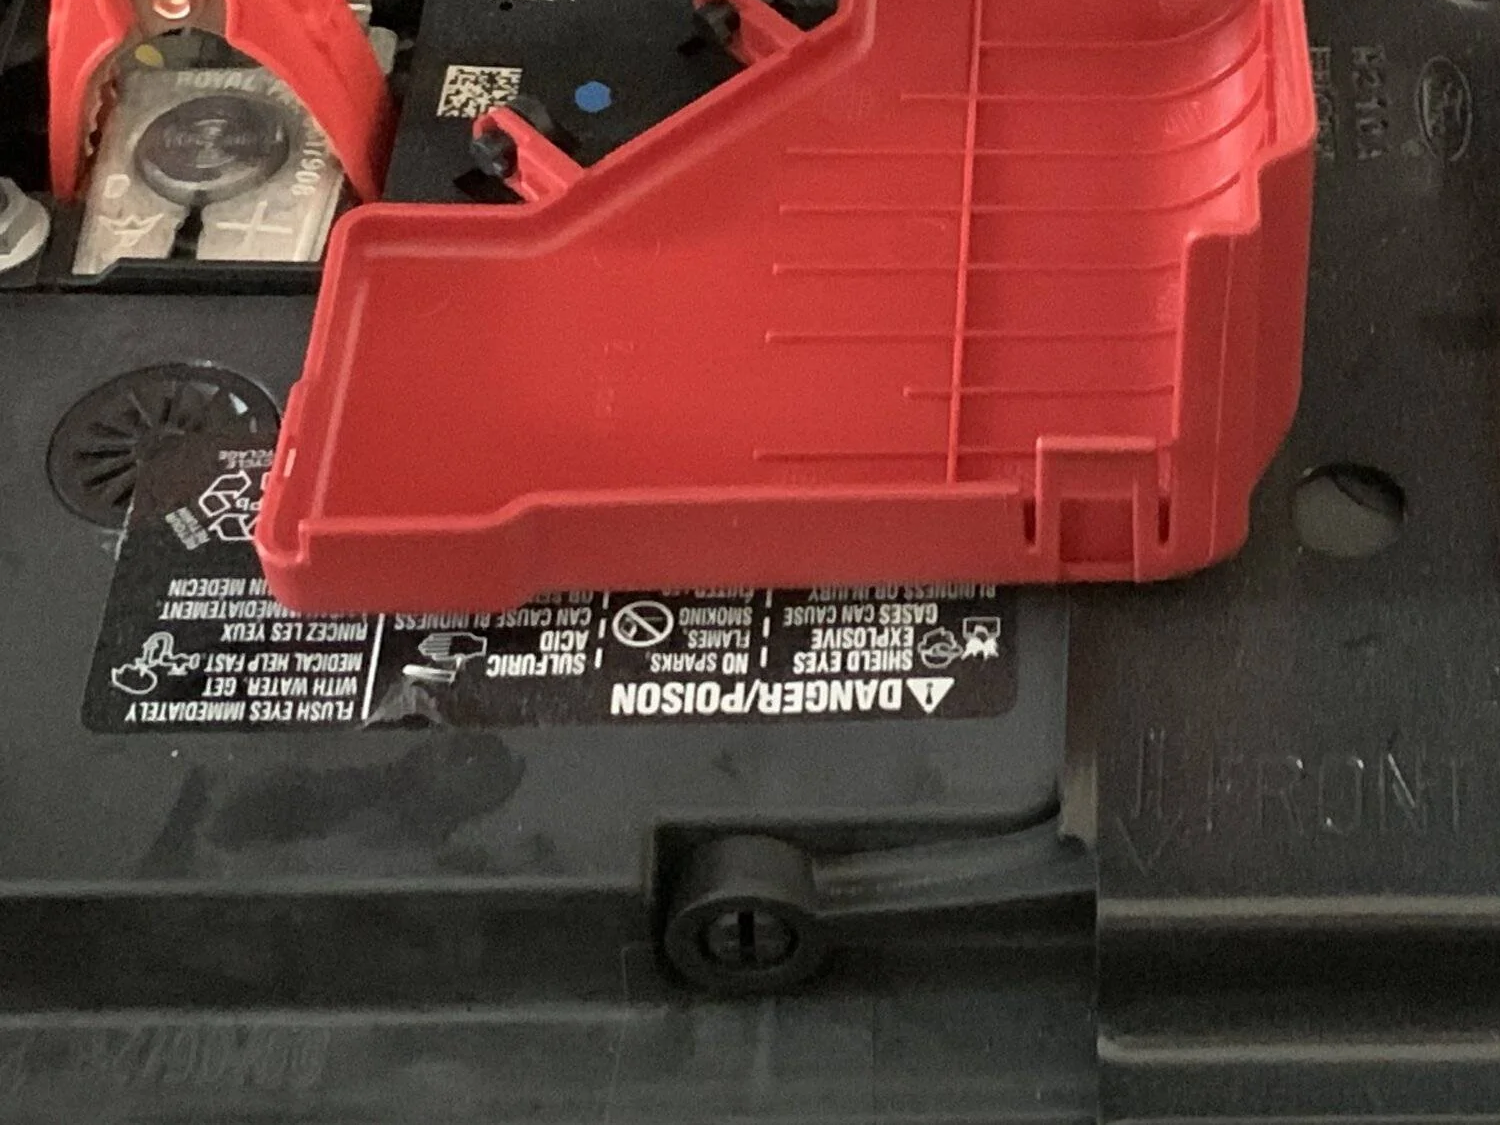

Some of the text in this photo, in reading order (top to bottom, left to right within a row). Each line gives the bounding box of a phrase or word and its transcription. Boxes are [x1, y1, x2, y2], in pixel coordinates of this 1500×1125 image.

[177, 71, 256, 92] ROYAL
[168, 579, 245, 600] MÉDECIN
[558, 606, 592, 626] CAN
[679, 607, 753, 627] SMOKING
[783, 602, 938, 627] GASES CAN CAUSE
[220, 623, 368, 642] RINCEZ LES YEUX
[539, 630, 589, 651] ACID
[811, 626, 913, 649] EXPLOSIVE
[248, 653, 290, 671] HELP
[294, 653, 363, 672] MEDICAL
[486, 653, 586, 676] SULFURIC
[722, 653, 748, 673] NO
[793, 649, 912, 673] SHIELD EYES
[202, 677, 237, 697] GET
[313, 677, 358, 695] WITH
[610, 678, 902, 714] DANGER/POISON
[124, 701, 354, 722] FLUSH EYES IMMEDIATELY
[1203, 743, 1484, 838] FRONT
